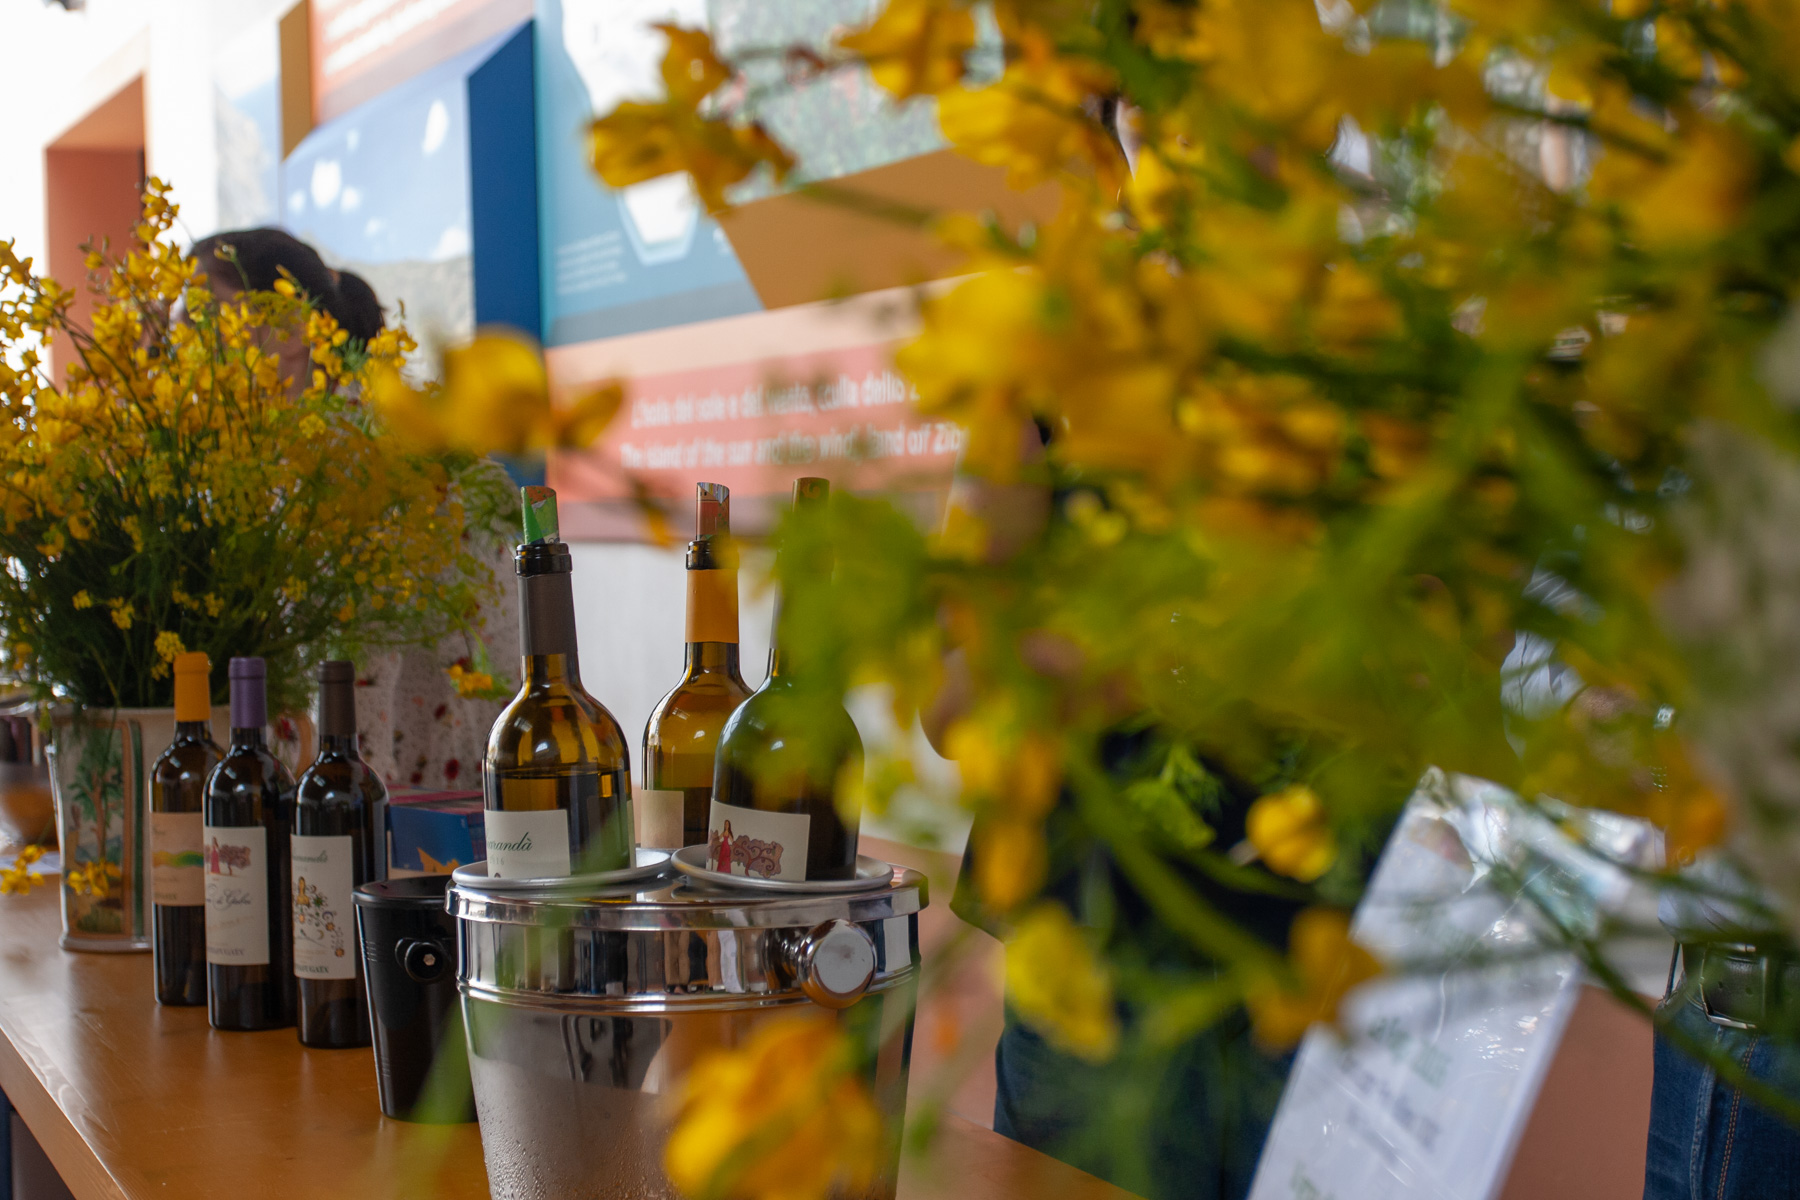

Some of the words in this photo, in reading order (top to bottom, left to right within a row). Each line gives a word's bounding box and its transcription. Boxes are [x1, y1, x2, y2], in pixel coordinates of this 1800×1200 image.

[728, 395, 739, 420] e
[741, 385, 764, 418] del
[619, 441, 644, 468] The
[646, 438, 683, 469] island
[685, 437, 701, 468] of
[702, 436, 725, 467] the
[727, 440, 754, 466] sun
[908, 423, 931, 456] of
